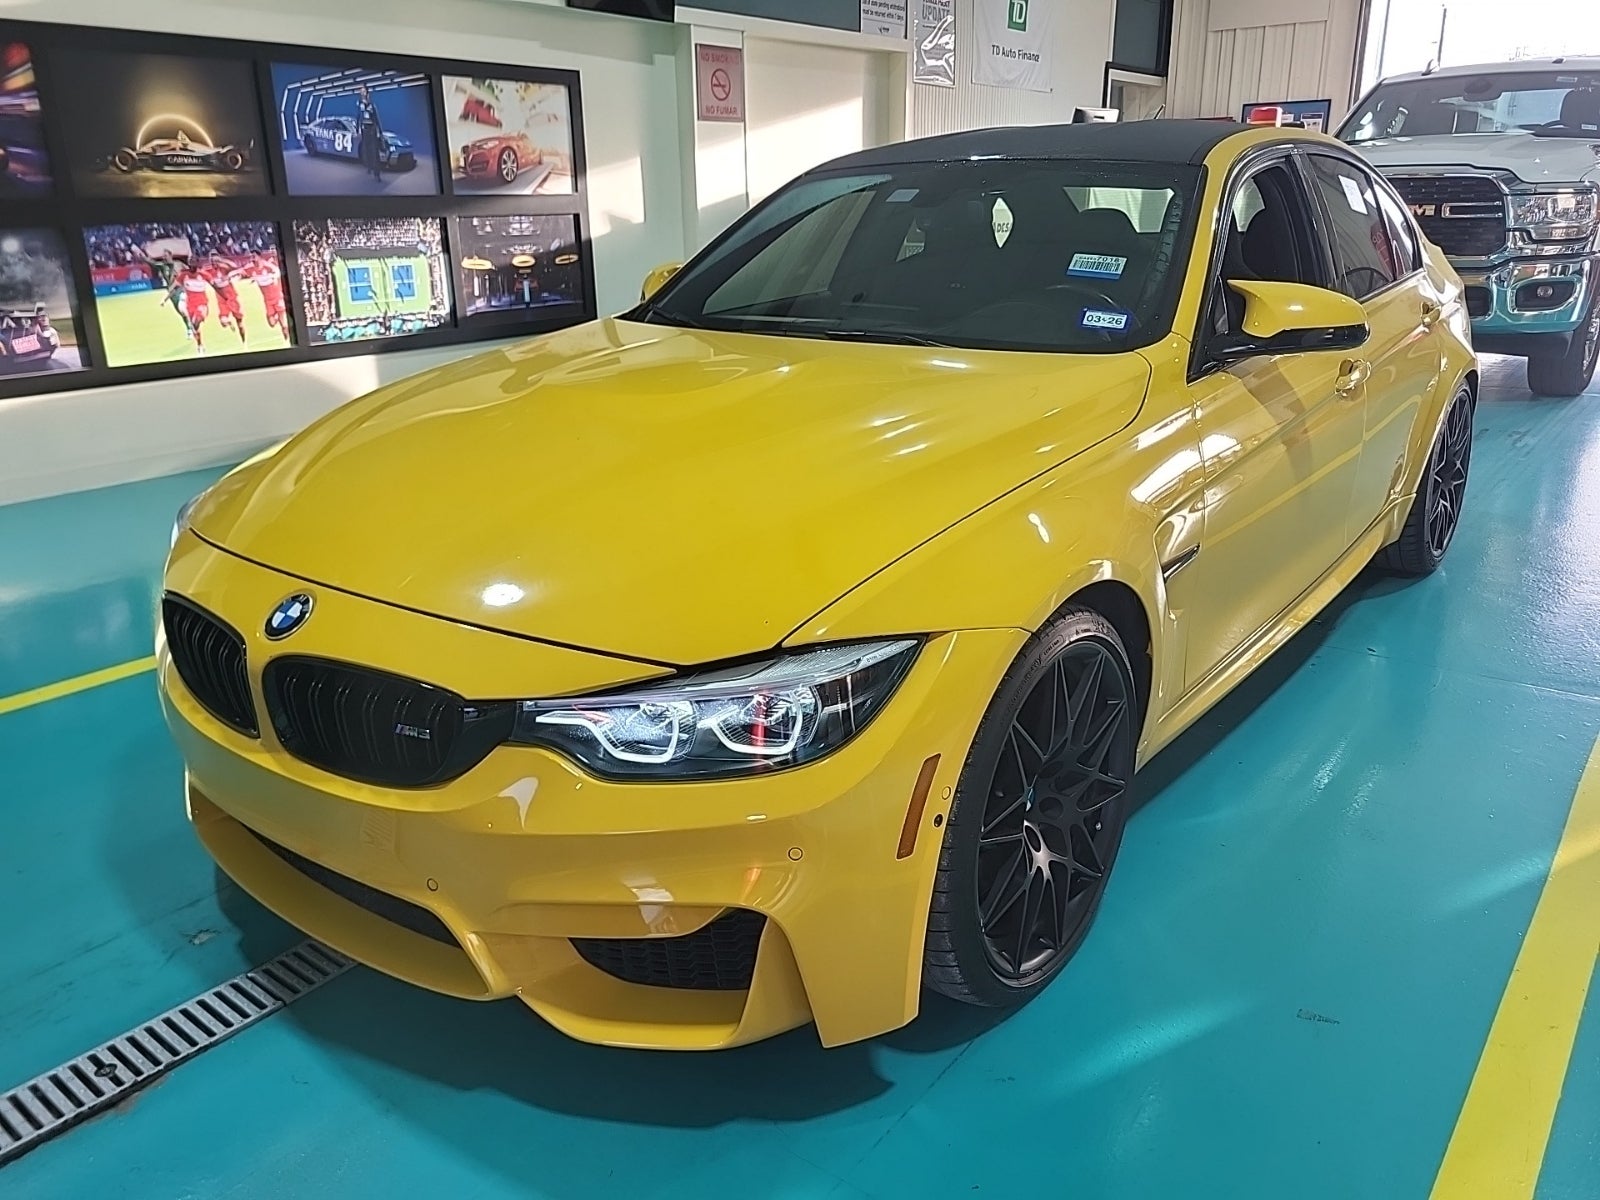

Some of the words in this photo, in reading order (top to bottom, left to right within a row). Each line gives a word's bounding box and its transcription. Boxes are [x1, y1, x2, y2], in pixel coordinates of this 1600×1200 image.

[1012, 0, 1026, 23] TD
[991, 44, 1001, 56] TD
[1001, 46, 1017, 59] Auto
[705, 104, 716, 115] NO
[716, 105, 738, 116] FUMAR
[334, 133, 353, 153] 84
[1086, 314, 1102, 324] 03
[1107, 316, 1123, 326] 26
